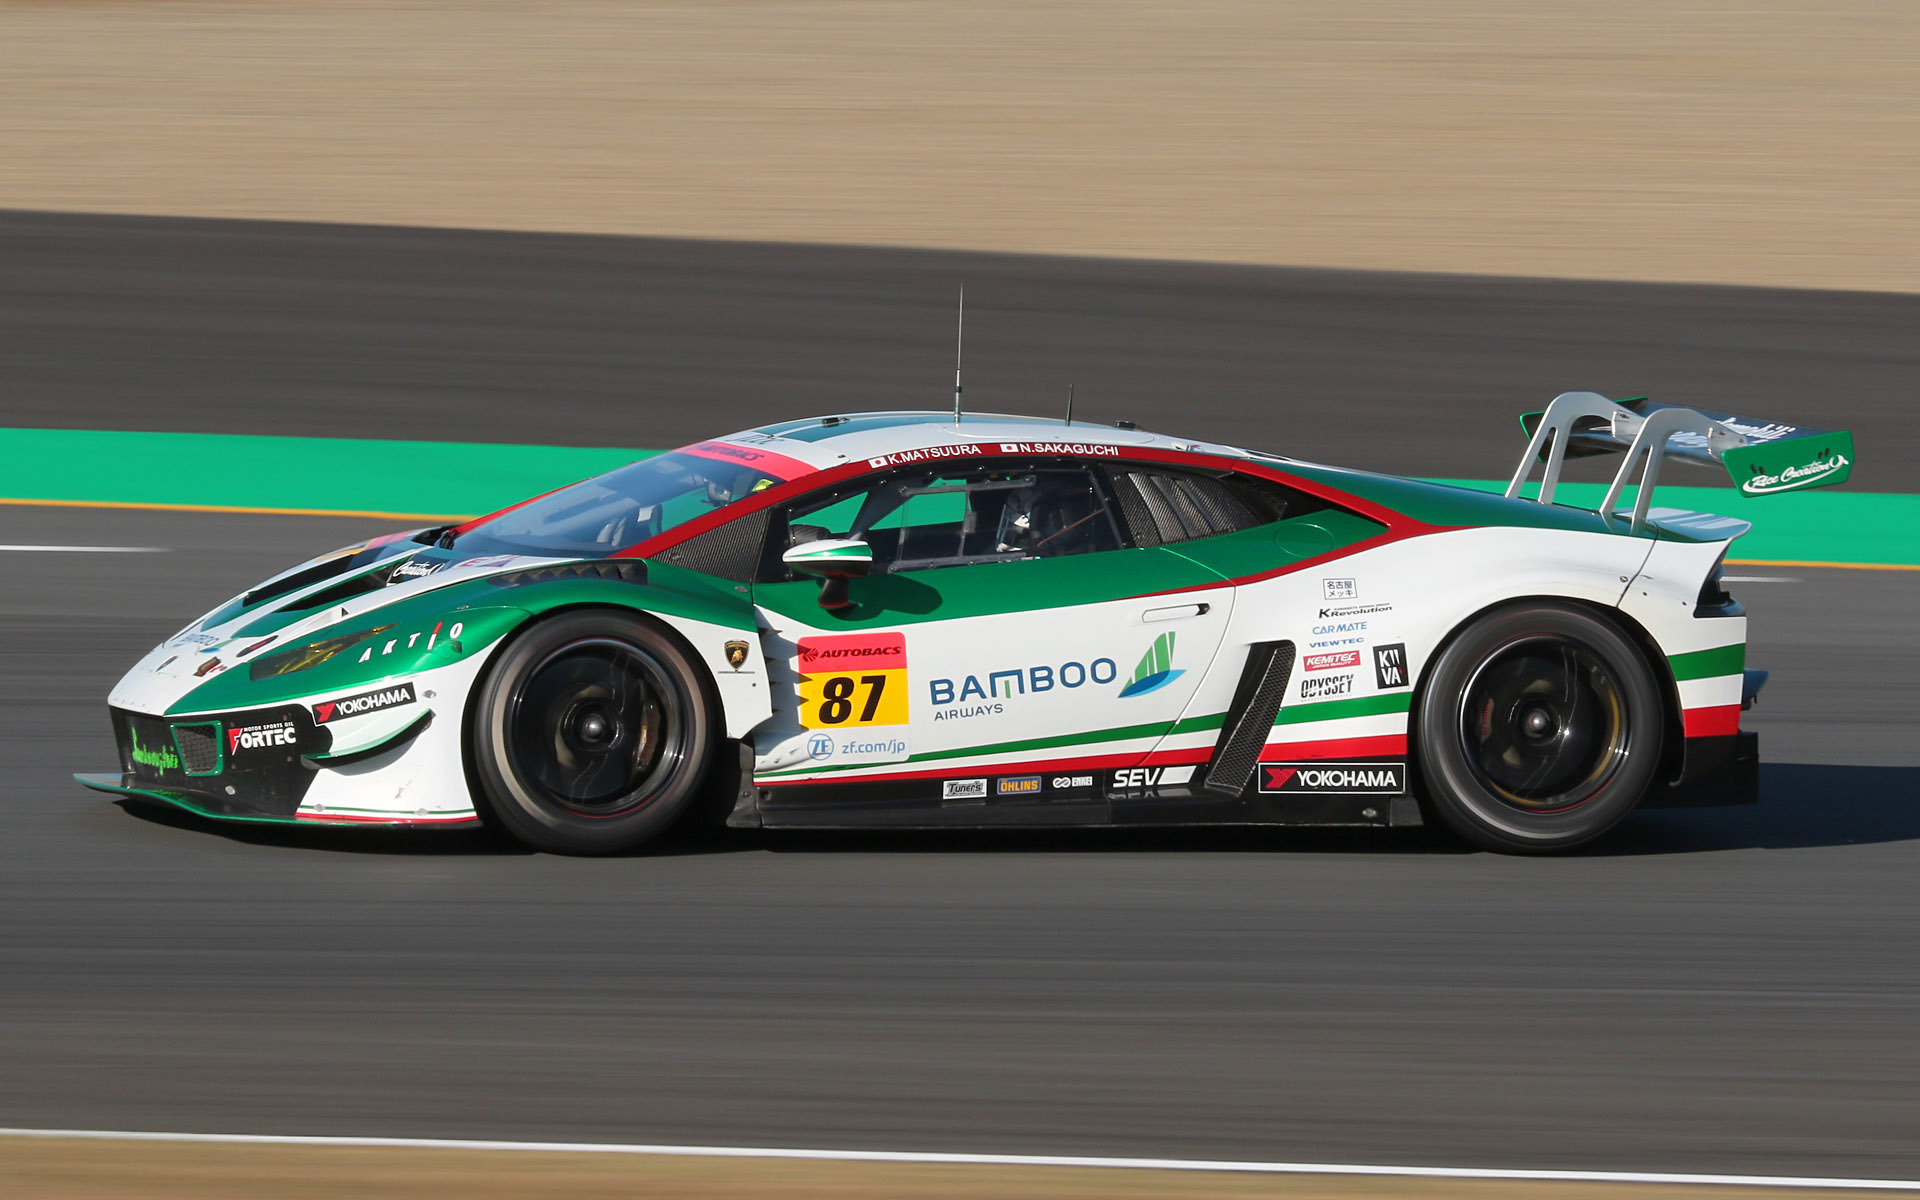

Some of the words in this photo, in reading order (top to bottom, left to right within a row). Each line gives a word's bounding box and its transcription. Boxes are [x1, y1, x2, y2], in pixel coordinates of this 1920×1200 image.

[887, 444, 982, 465] K.MATSUURA
[1019, 442, 1119, 457] N.SAKAGUCHI
[1780, 461, 1830, 483] Creation
[1327, 580, 1353, 590] 名古屋
[1328, 589, 1354, 598] メッキ
[358, 621, 464, 664] AKTIO
[819, 646, 902, 659] AUTOBACS
[929, 657, 1117, 706] BAMBOO
[1300, 674, 1354, 698] ODYSSEY
[335, 687, 412, 716] YOKOHAMA
[818, 674, 887, 725] 87
[934, 703, 1004, 721] AIRWAYS
[808, 737, 834, 757] ZF
[842, 739, 906, 754] zf.com/jp
[1000, 778, 1039, 792] ÖHLINS
[1112, 767, 1161, 788] SEV
[1296, 770, 1397, 787] YOKOHAMA
